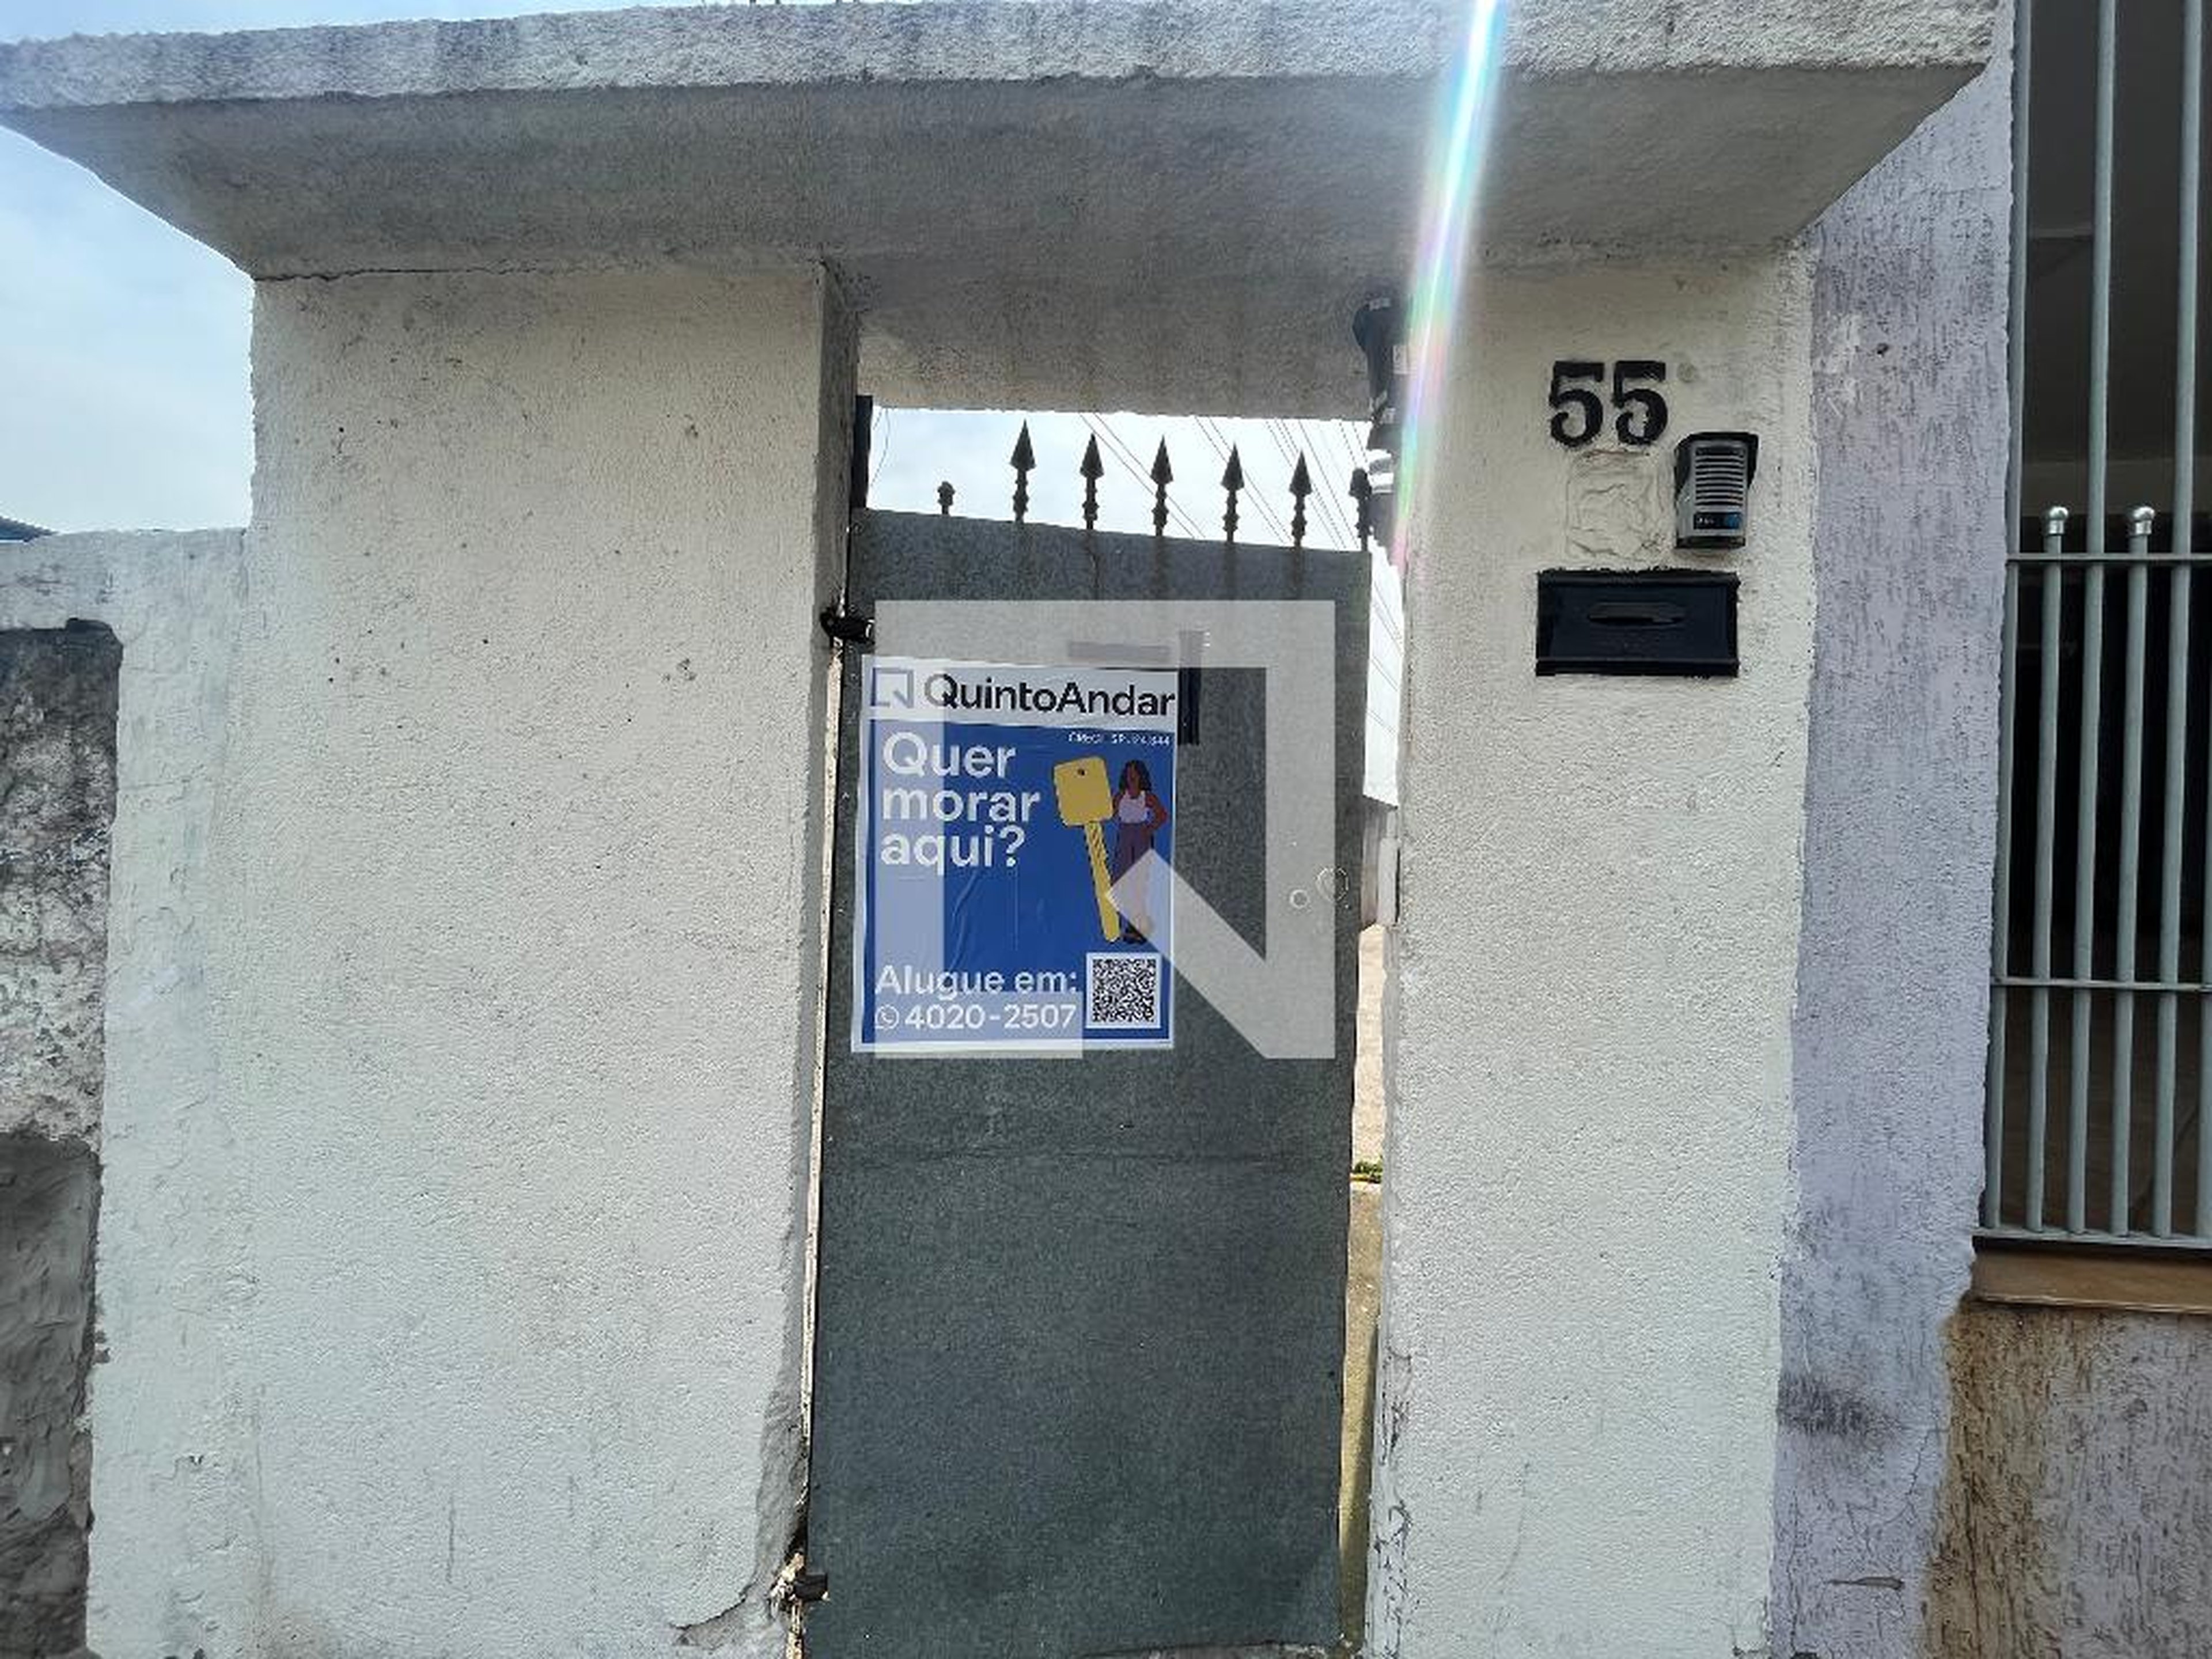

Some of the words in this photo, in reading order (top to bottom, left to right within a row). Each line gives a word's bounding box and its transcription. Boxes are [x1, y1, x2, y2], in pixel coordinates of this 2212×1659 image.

[1549, 360, 1668, 448] 55
[924, 672, 1176, 717] QuintoAndar
[882, 731, 1016, 778] Quer
[881, 789, 1041, 822] morar
[880, 825, 1026, 876] aqui?
[874, 964, 1005, 1001] Alugue
[1014, 969, 1078, 995] em:
[904, 1003, 1077, 1029] 4020-2507
